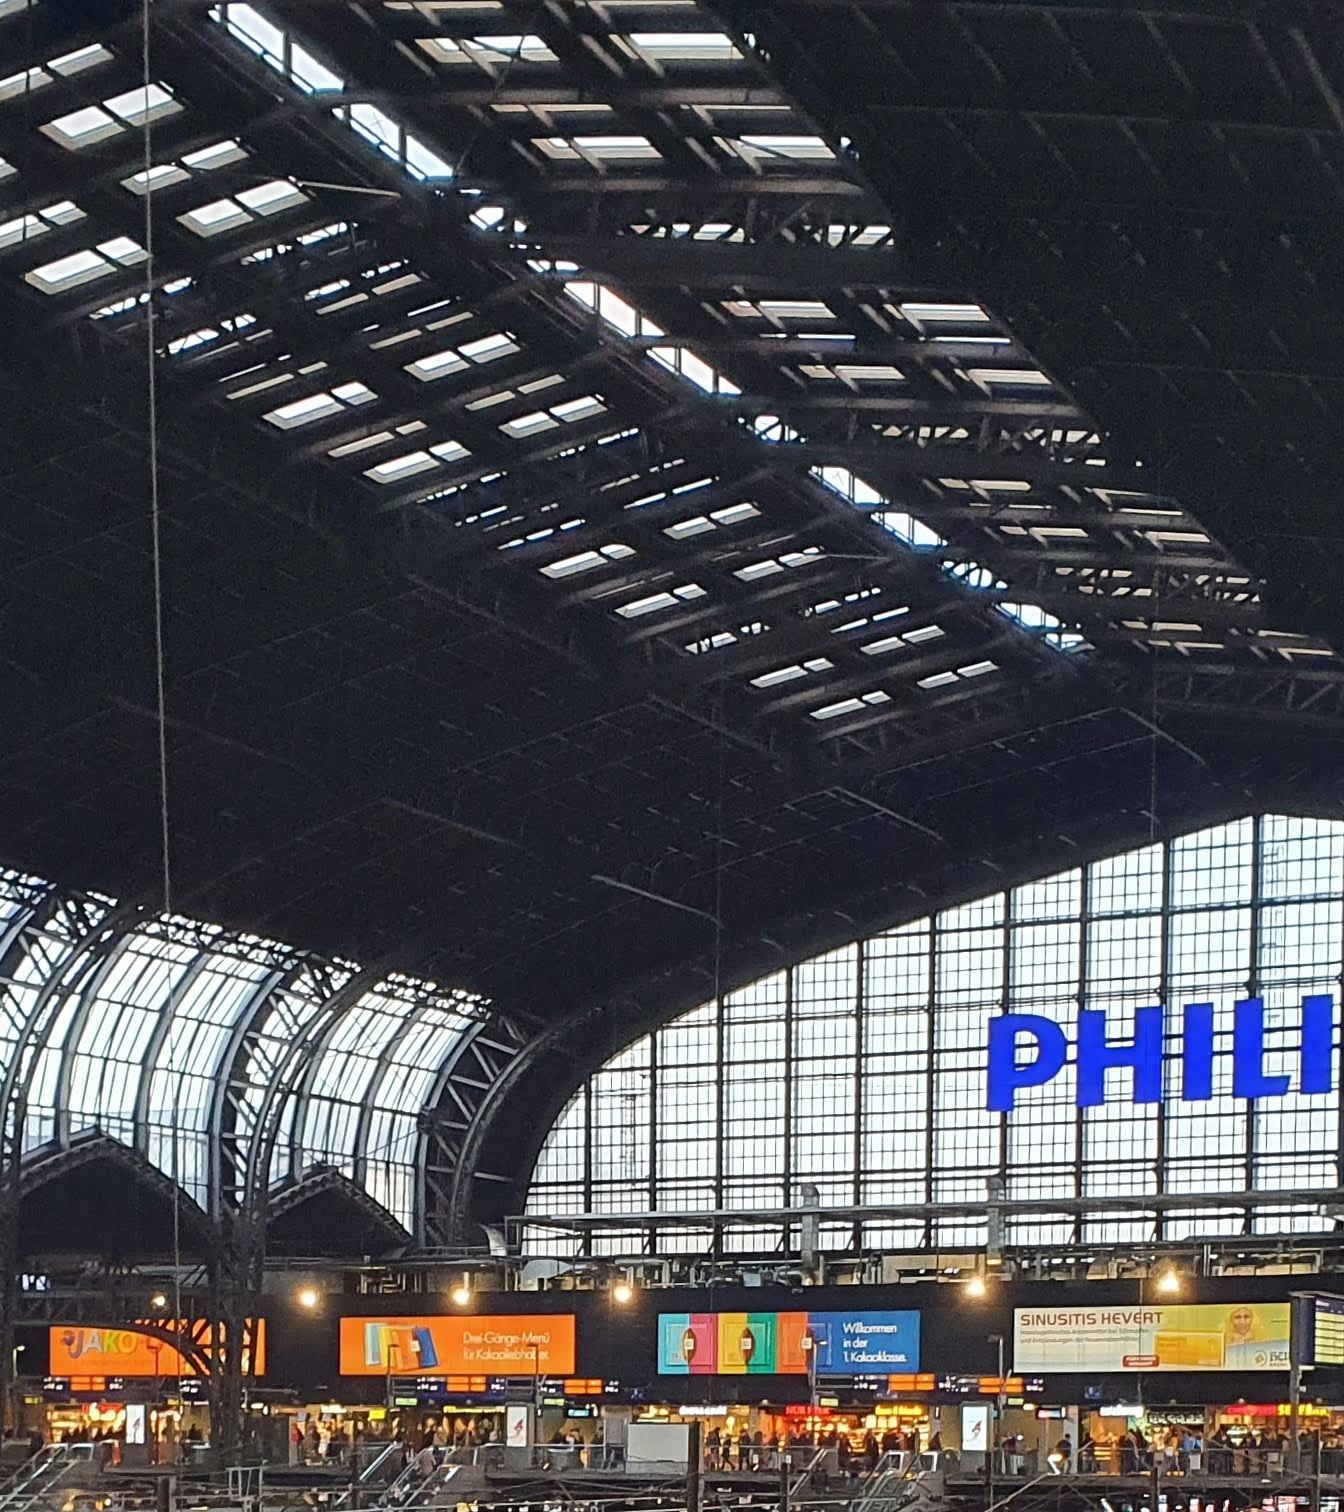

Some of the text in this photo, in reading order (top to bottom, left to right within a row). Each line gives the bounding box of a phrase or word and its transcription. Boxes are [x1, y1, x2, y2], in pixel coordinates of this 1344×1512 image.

[1020, 1312, 1163, 1326] SINUSITIS HEVERT
[843, 1321, 898, 1334] Willkommen
[843, 1336, 869, 1348] in der
